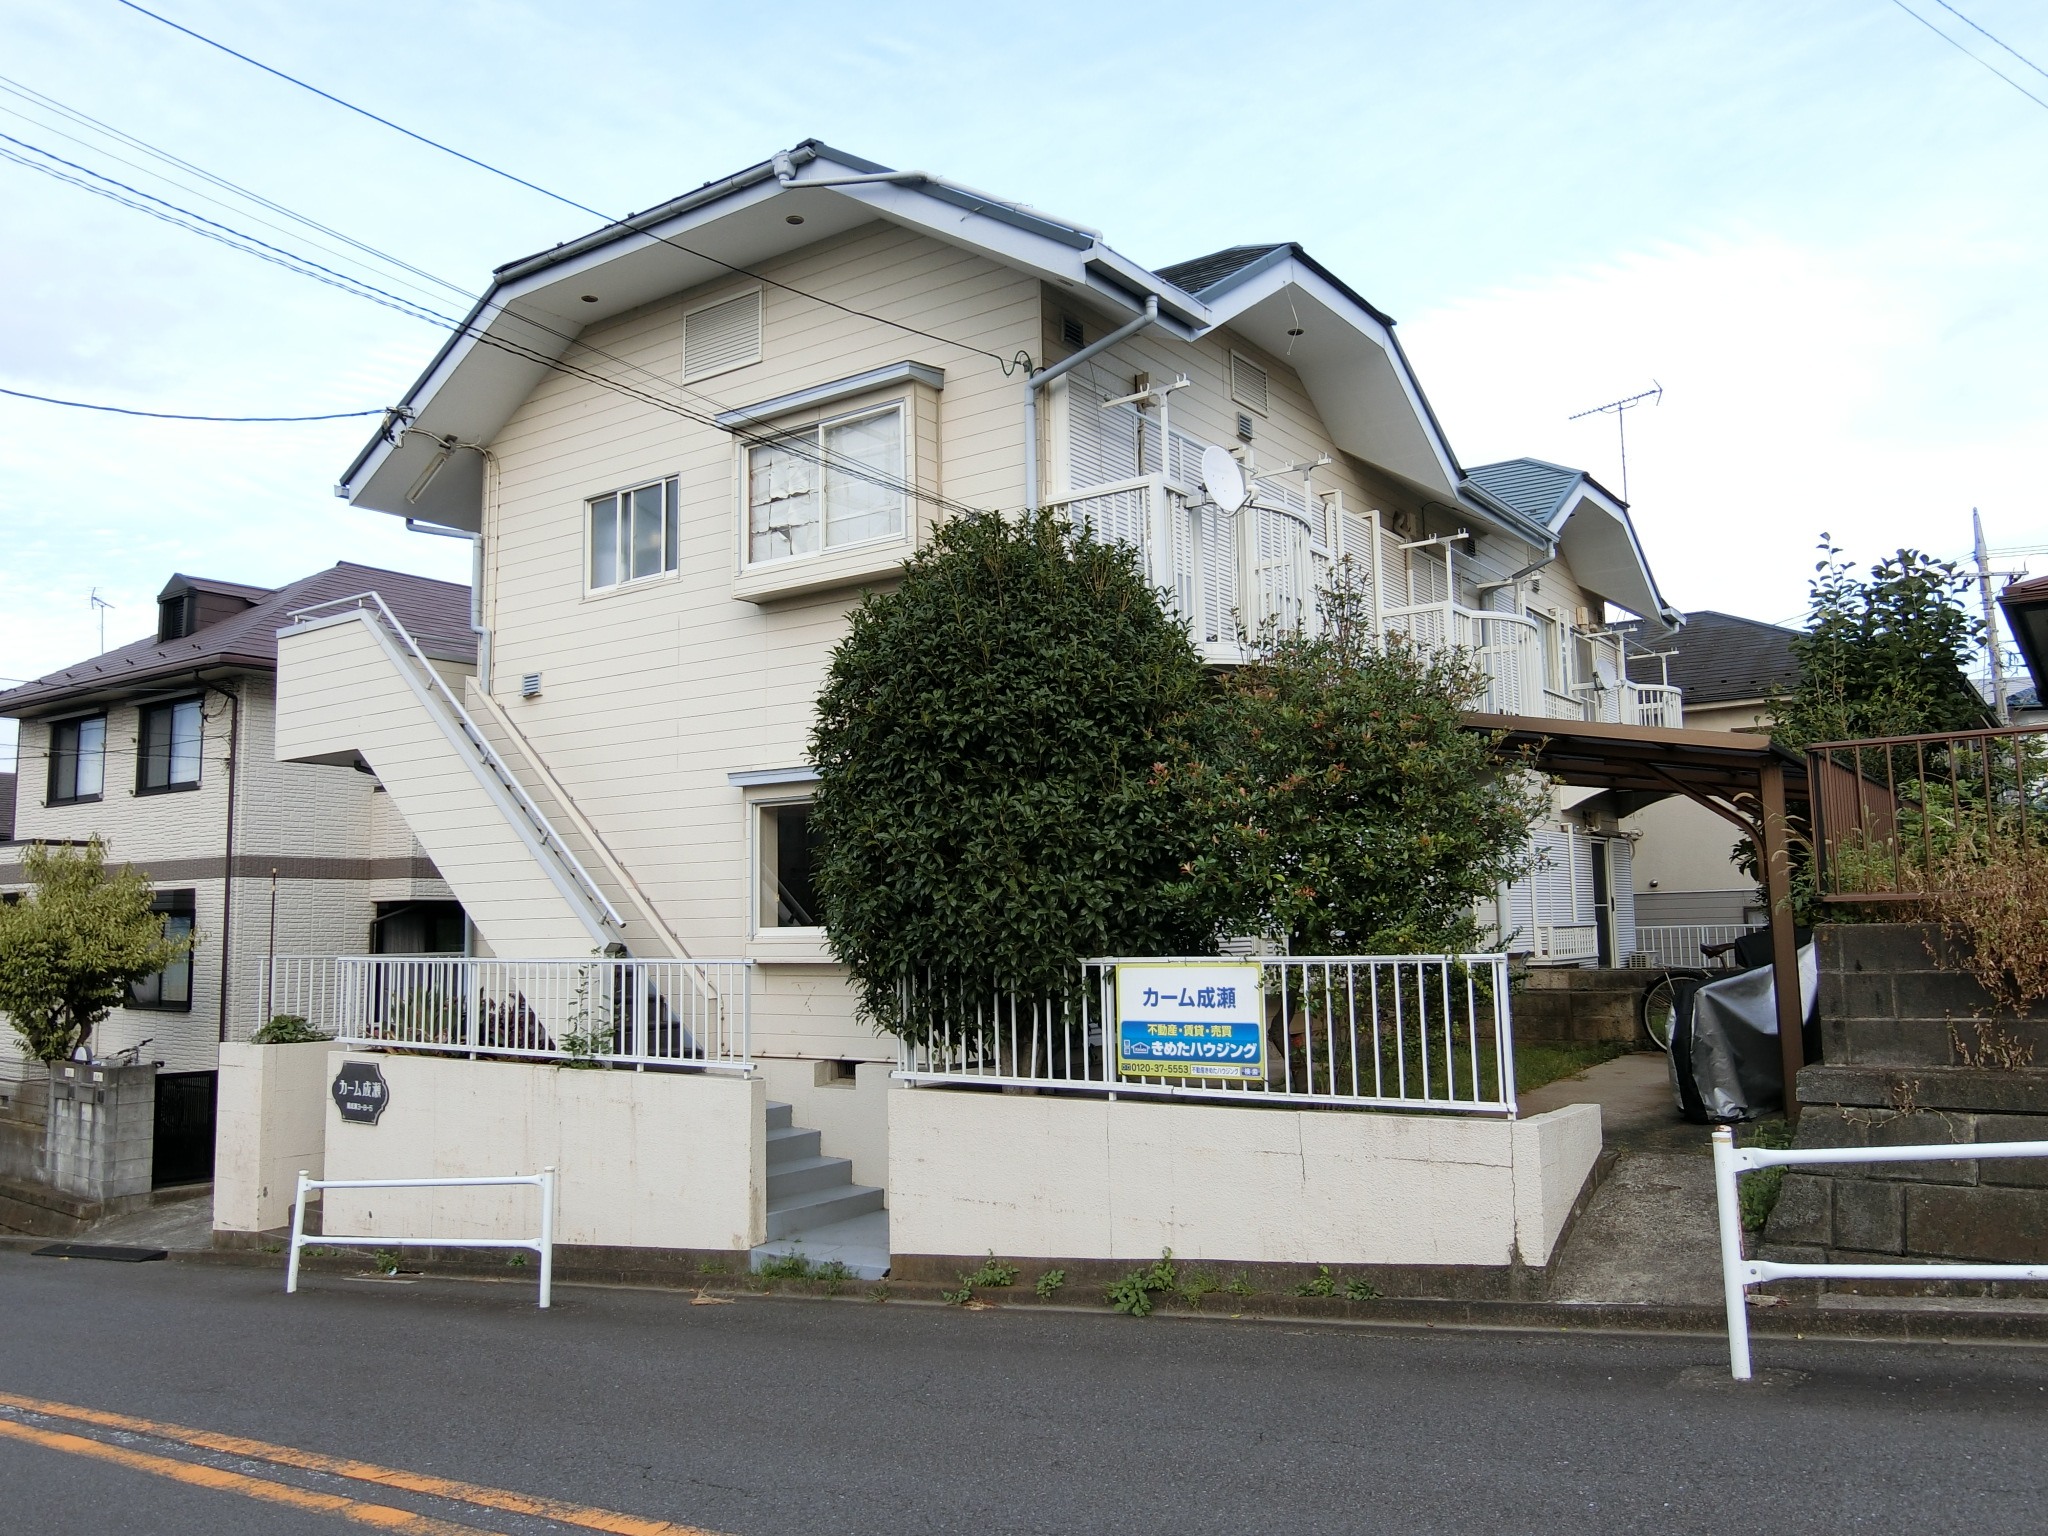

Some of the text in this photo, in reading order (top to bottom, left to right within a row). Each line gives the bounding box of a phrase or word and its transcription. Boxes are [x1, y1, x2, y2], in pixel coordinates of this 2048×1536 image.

[1143, 987, 1236, 1009] カーム成瀬
[1151, 1041, 1257, 1059] きめたハウジング
[1131, 1063, 1188, 1074] 0120-37-5553
